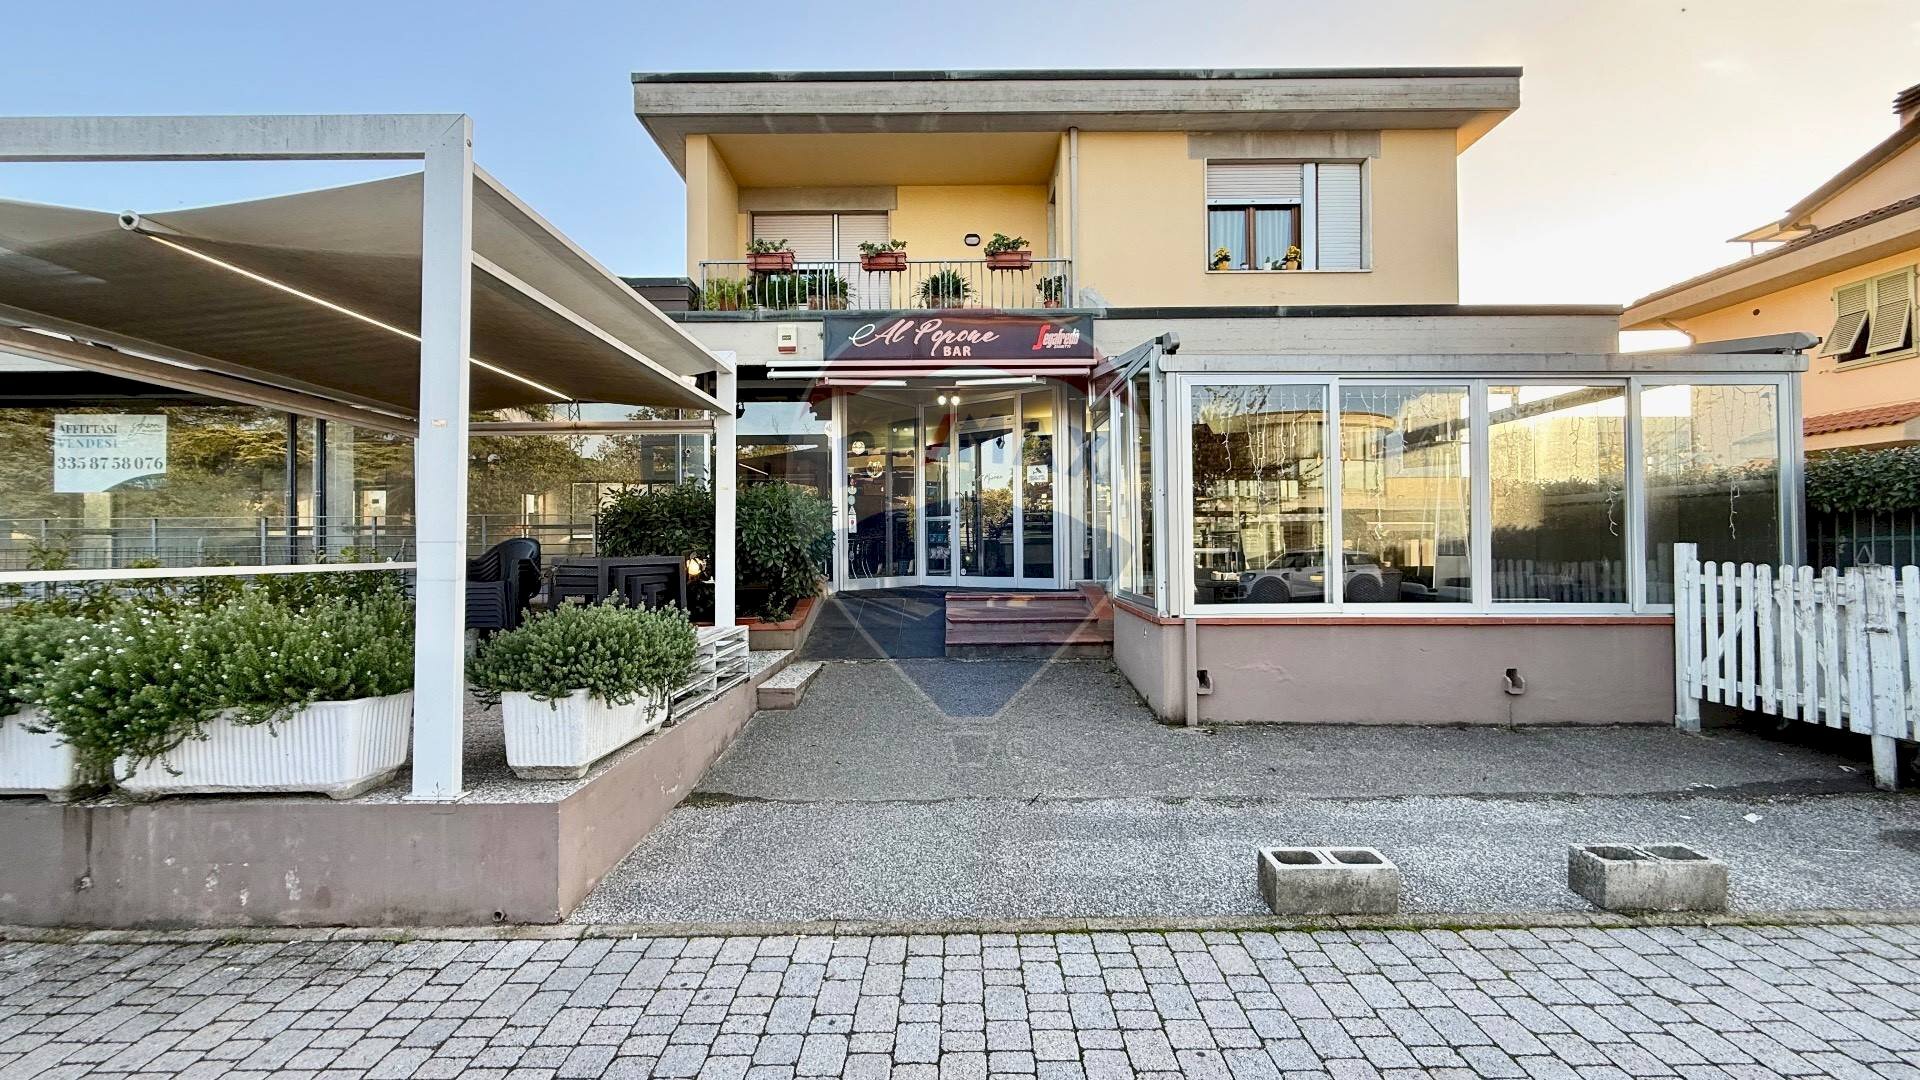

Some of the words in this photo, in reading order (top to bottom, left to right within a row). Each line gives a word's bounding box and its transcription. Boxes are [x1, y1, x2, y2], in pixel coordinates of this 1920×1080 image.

[848, 318, 913, 348] Al
[943, 345, 972, 357] BAR
[58, 424, 118, 434] AFFITTASI
[57, 438, 118, 449] VENDESI
